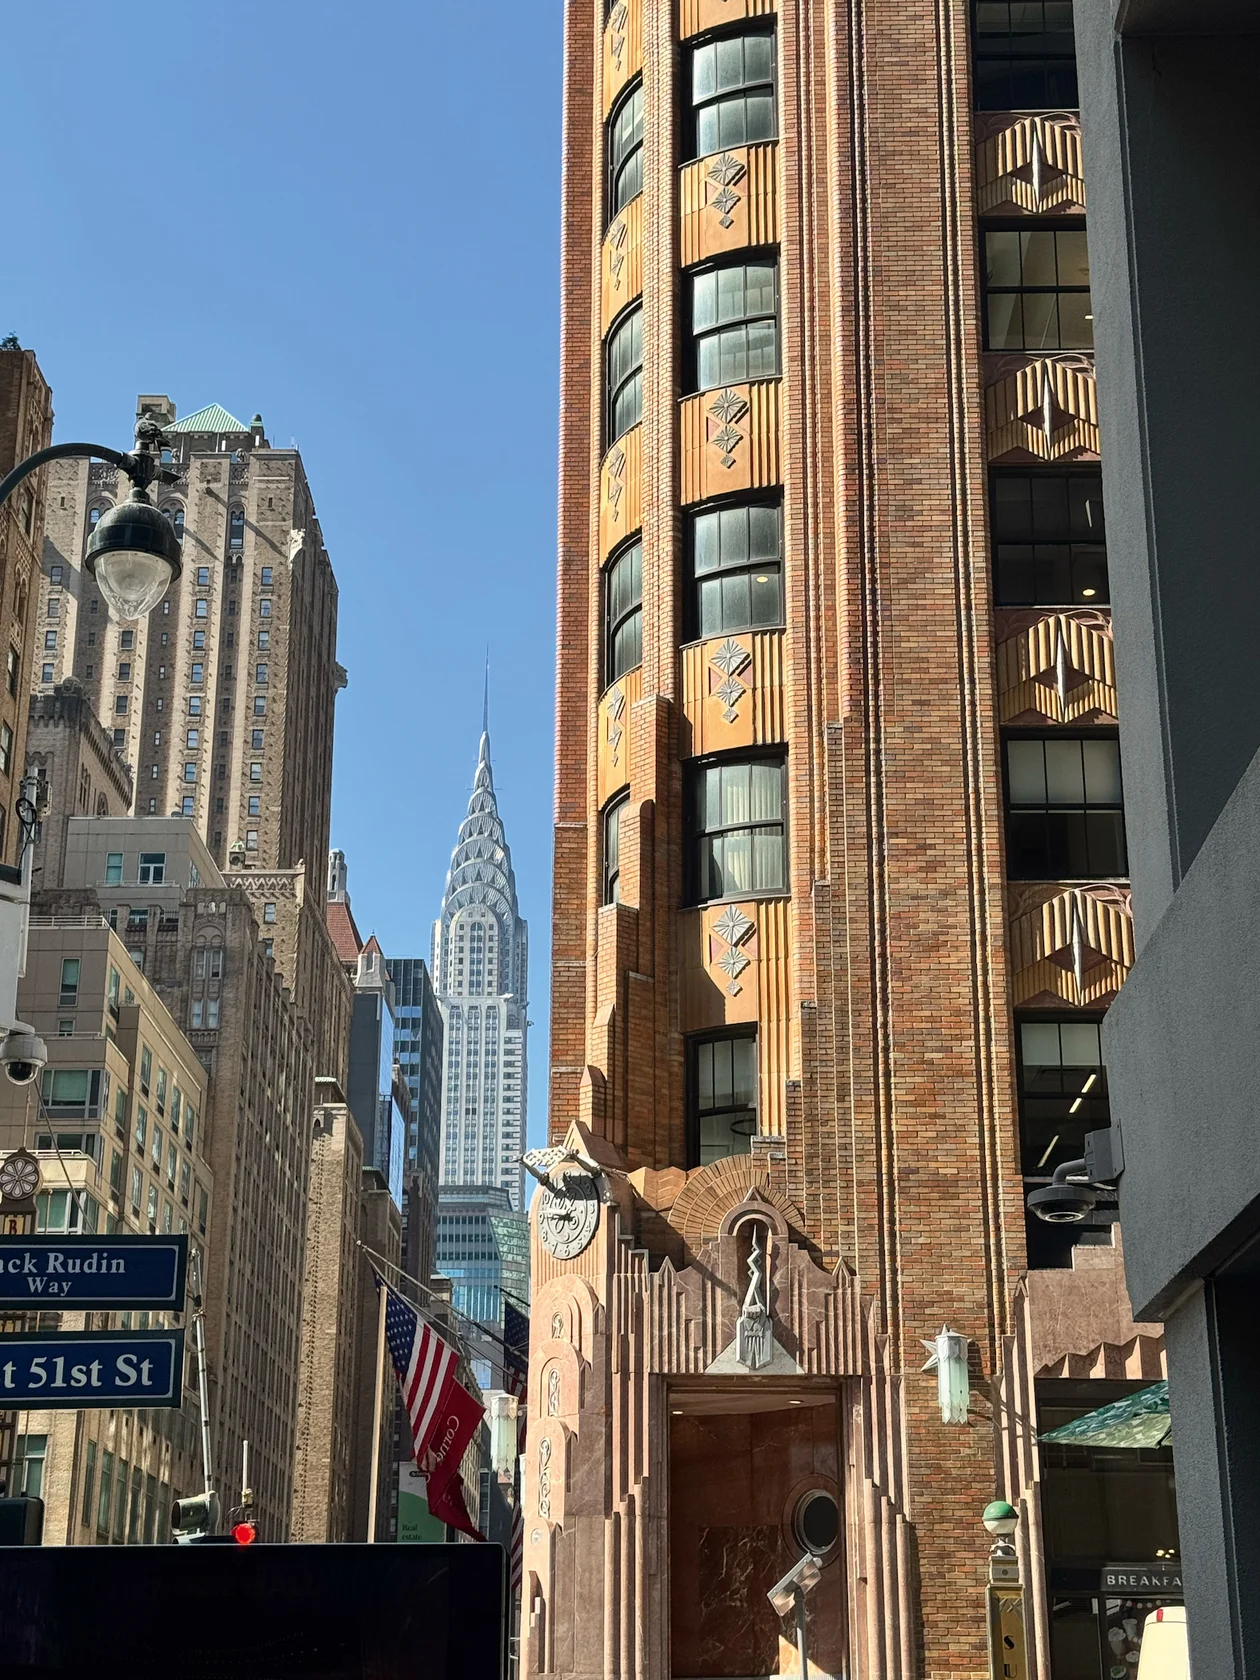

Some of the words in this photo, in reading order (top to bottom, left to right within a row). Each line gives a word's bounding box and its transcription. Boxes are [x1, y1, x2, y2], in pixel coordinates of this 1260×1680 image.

[45, 1252, 126, 1274] Rudin
[26, 1276, 72, 1297] Way
[27, 1356, 104, 1389] 51st
[114, 1353, 154, 1387] St
[402, 1524, 418, 1532] Real
[401, 1533, 422, 1541] estate
[1106, 1574, 1182, 1587] BREAKFA
